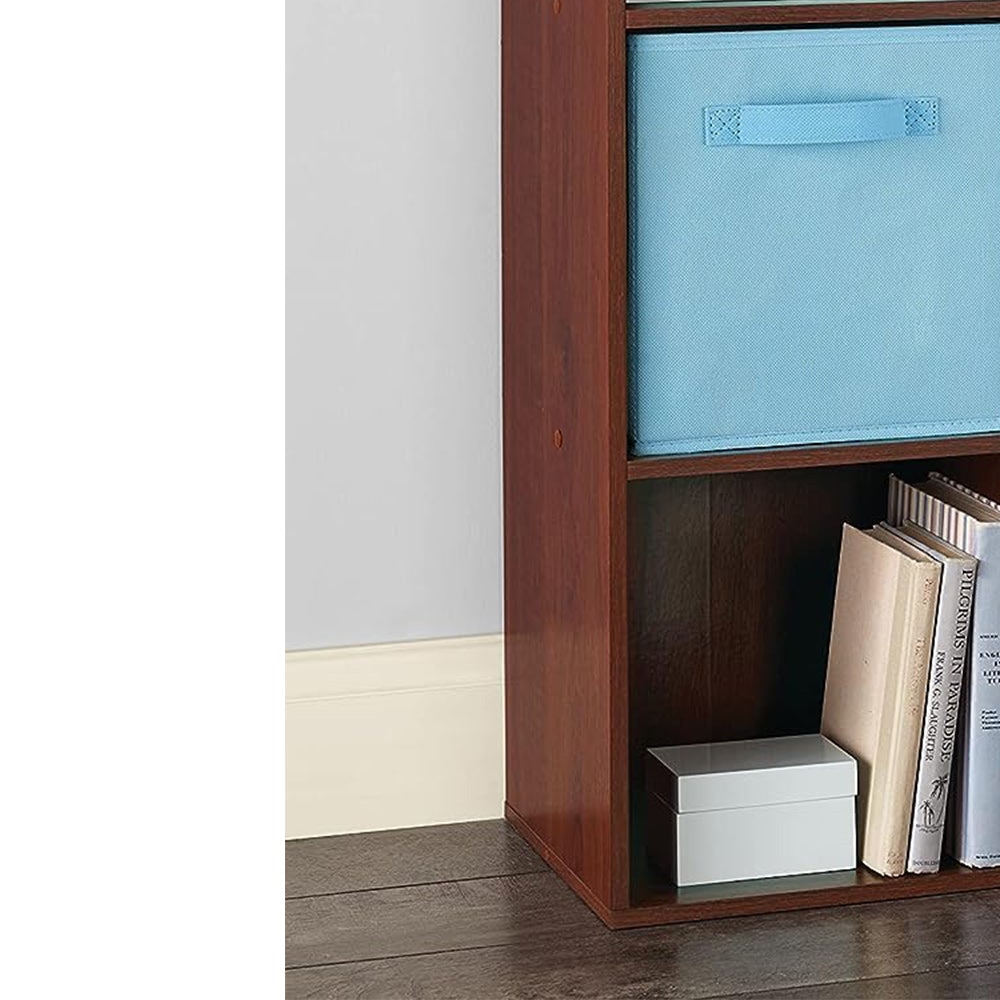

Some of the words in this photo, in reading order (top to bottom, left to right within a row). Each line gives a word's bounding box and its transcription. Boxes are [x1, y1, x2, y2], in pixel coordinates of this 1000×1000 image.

[953, 568, 974, 649] PILGRIMS
[933, 651, 946, 686] FRANK
[950, 656, 964, 675] IN
[924, 701, 940, 762] SLAUGHTER
[940, 682, 962, 763] PARADISE
